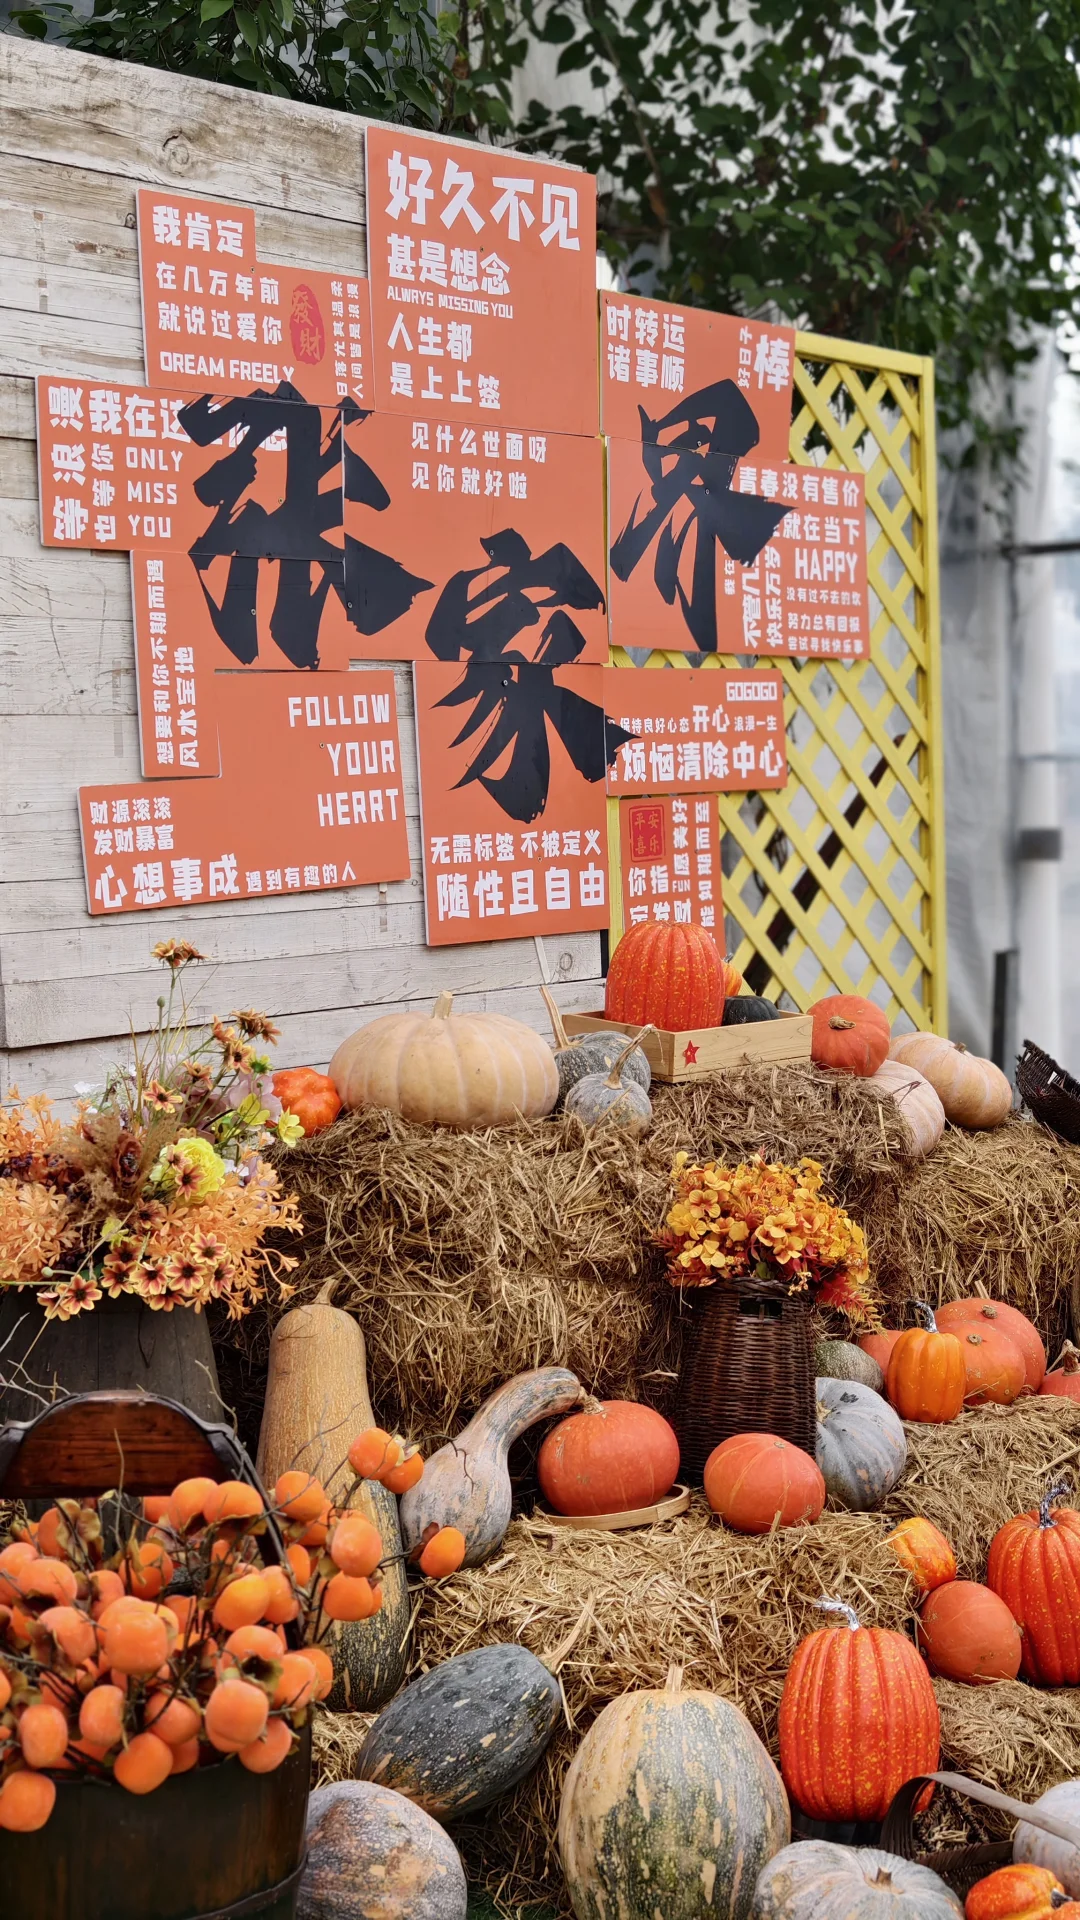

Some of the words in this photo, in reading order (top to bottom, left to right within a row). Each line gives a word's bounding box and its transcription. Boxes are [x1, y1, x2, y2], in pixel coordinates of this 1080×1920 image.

[385, 150, 580, 251] 好久不见
[153, 205, 244, 258] 我肯定
[156, 261, 280, 306] 在几万年前
[387, 233, 510, 296] 甚是想念
[158, 302, 283, 346] 就说过爱你
[438, 293, 489, 316] MISSING
[490, 303, 514, 319] YOU
[330, 280, 348, 397] 日落尤其温柔
[346, 283, 364, 399] 人间皆是浪漫
[387, 312, 472, 363] 人生都
[606, 304, 685, 353] 时转运
[229, 359, 295, 384] FREELY
[607, 342, 685, 393] 诸事顺
[753, 334, 790, 392] 棒
[390, 361, 501, 410] 是上上签
[48, 386, 89, 541] 等浪漫
[126, 446, 183, 472] ONLY
[411, 422, 546, 463] 见什么世面呀
[91, 442, 117, 543] 也等你
[127, 480, 178, 505] MISS
[411, 462, 527, 499] 见你就好啦
[739, 466, 860, 508] 青春没有售价
[128, 514, 171, 539] YOU
[772, 512, 860, 546] 就在当下
[794, 547, 858, 584] HAPPY
[787, 612, 860, 633] 努力总有回报
[146, 559, 174, 765] 想要和你不期而遇
[173, 646, 200, 768] 风水宝地
[287, 693, 390, 728] FOLLOW
[725, 681, 778, 702] GOGOGO
[692, 704, 731, 733] 开心
[734, 715, 778, 732] 浪漫一生
[326, 739, 396, 777] YOUR
[621, 739, 784, 783] 烦恼清除中心
[90, 796, 172, 826] 财源滚滚
[93, 825, 174, 856] 发财暴富
[430, 832, 515, 864] 无需标签
[520, 829, 602, 859] 不被定义
[94, 853, 240, 909] 心想事成
[245, 861, 357, 893] 遇到有趣的人
[436, 862, 605, 922] 随性且自由
[628, 865, 669, 897] 你指
[672, 879, 691, 893] FUN
[695, 801, 716, 944] 能如期而至
